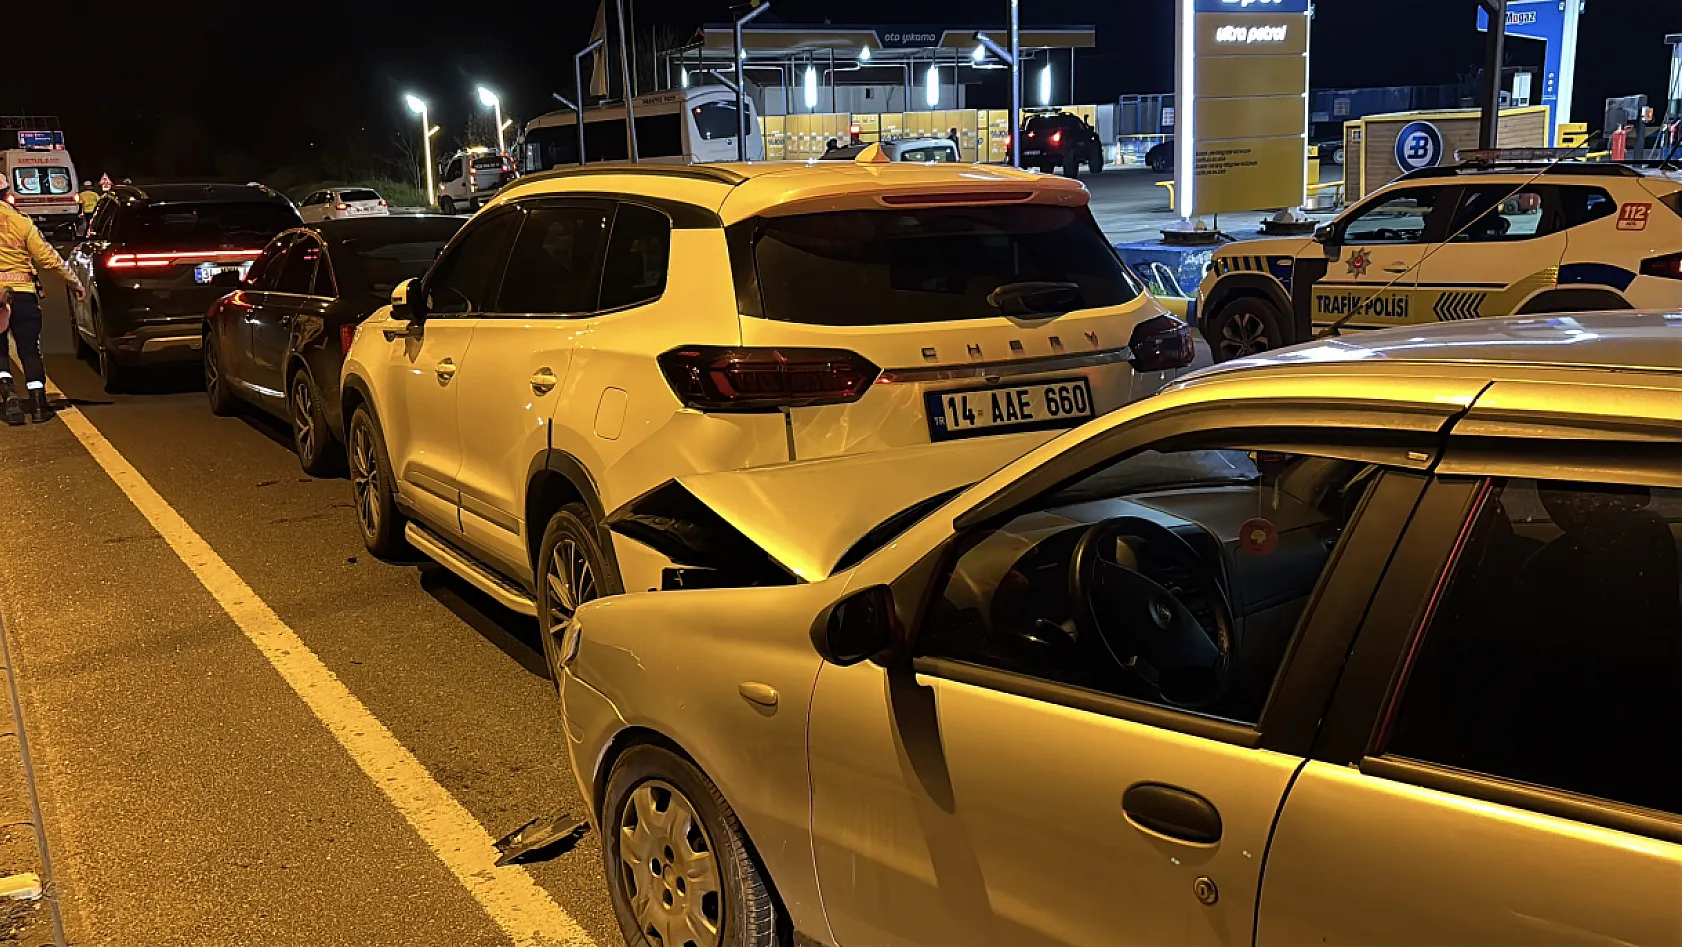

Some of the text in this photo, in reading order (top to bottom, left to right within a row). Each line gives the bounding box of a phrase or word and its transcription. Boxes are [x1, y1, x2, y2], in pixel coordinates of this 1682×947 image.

[884, 33, 900, 41] oto
[1216, 25, 1287, 43] ultra petrol
[1624, 206, 1646, 218] 112
[1316, 292, 1409, 318] TRAFİK POLİSİ
[921, 331, 1099, 360] CHERY
[934, 384, 1087, 427] TR 14 AAE 660
